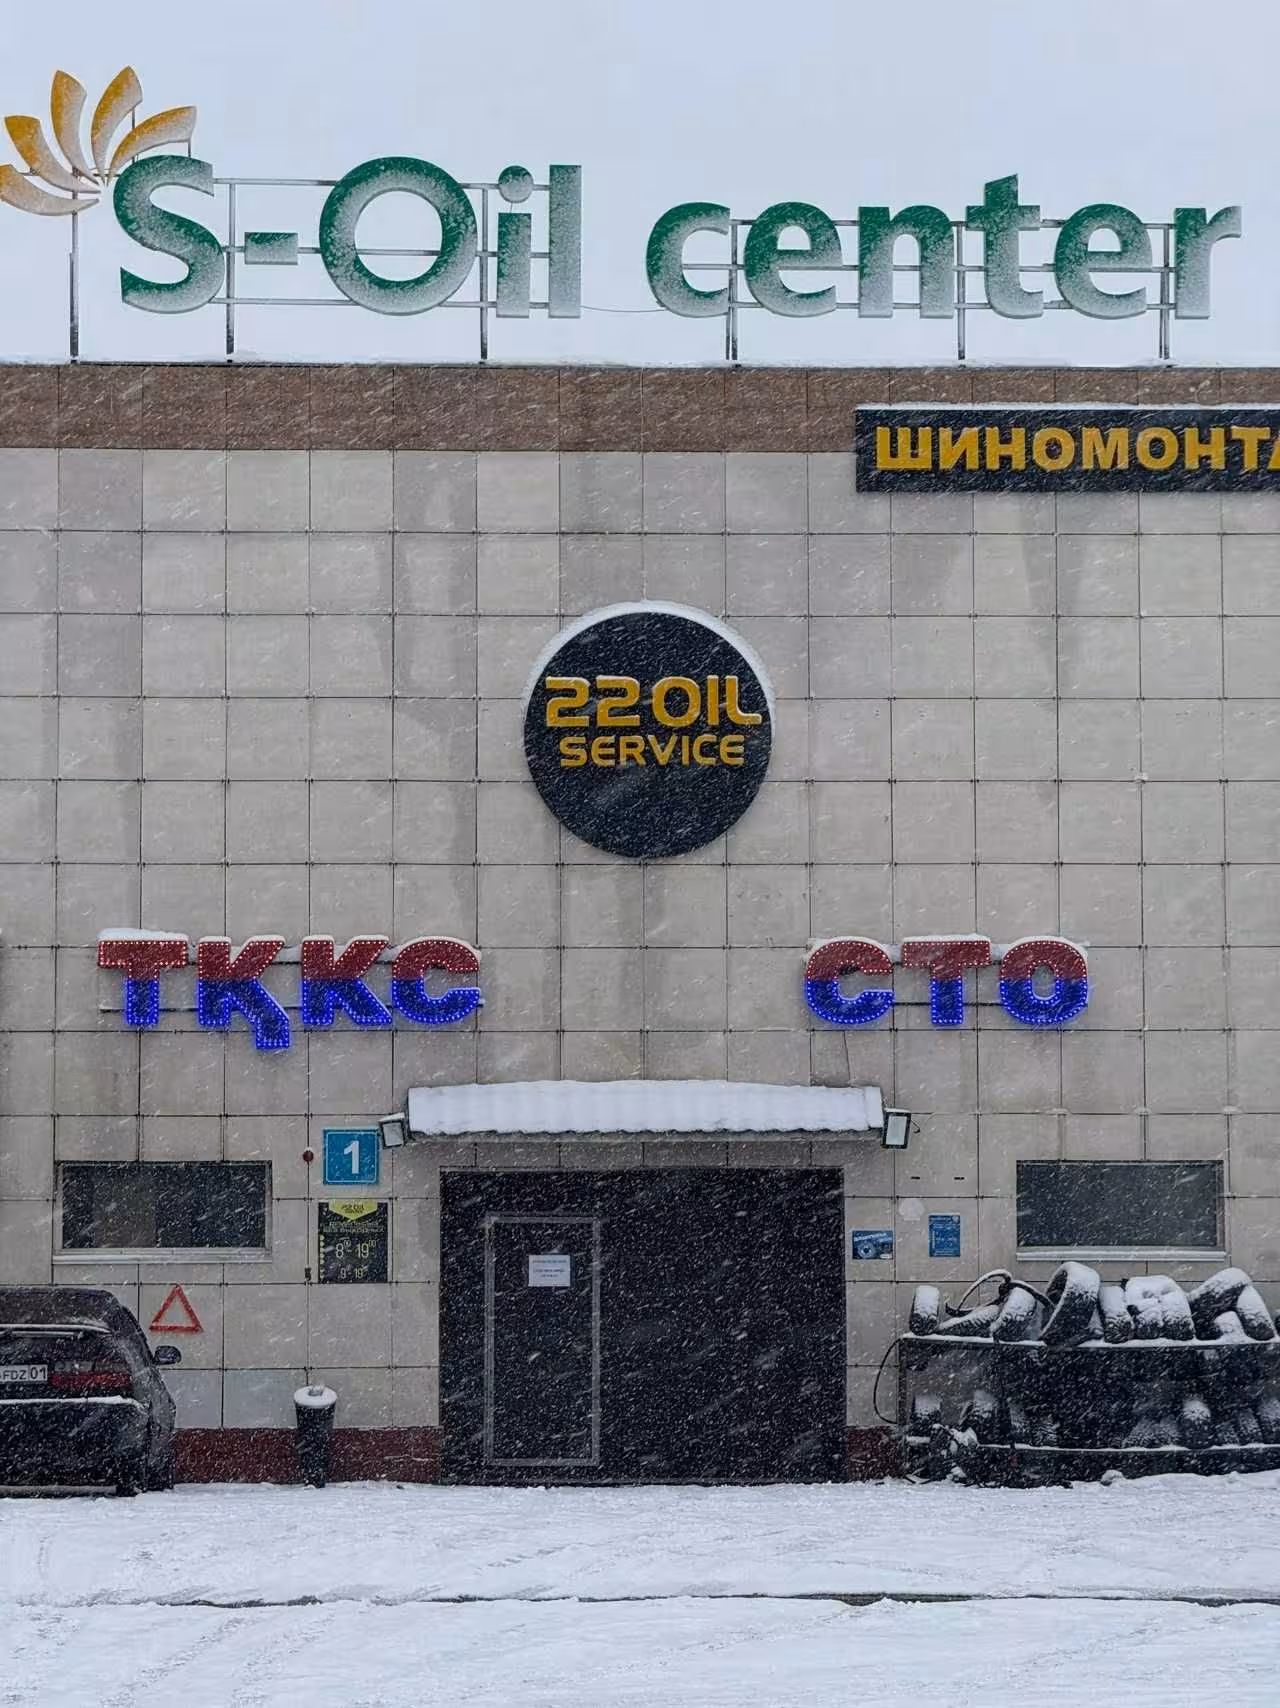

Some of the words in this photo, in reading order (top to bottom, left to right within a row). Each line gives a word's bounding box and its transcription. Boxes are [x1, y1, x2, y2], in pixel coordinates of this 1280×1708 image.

[113, 154, 582, 319] S-Oil
[646, 174, 1242, 319] center
[545, 675, 641, 727] 22
[652, 675, 763, 728] OIL
[559, 735, 745, 767] SERVICE
[804, 936, 1088, 1024] СТО
[343, 1140, 360, 1174] 1
[30, 1366, 47, 1380] 01
